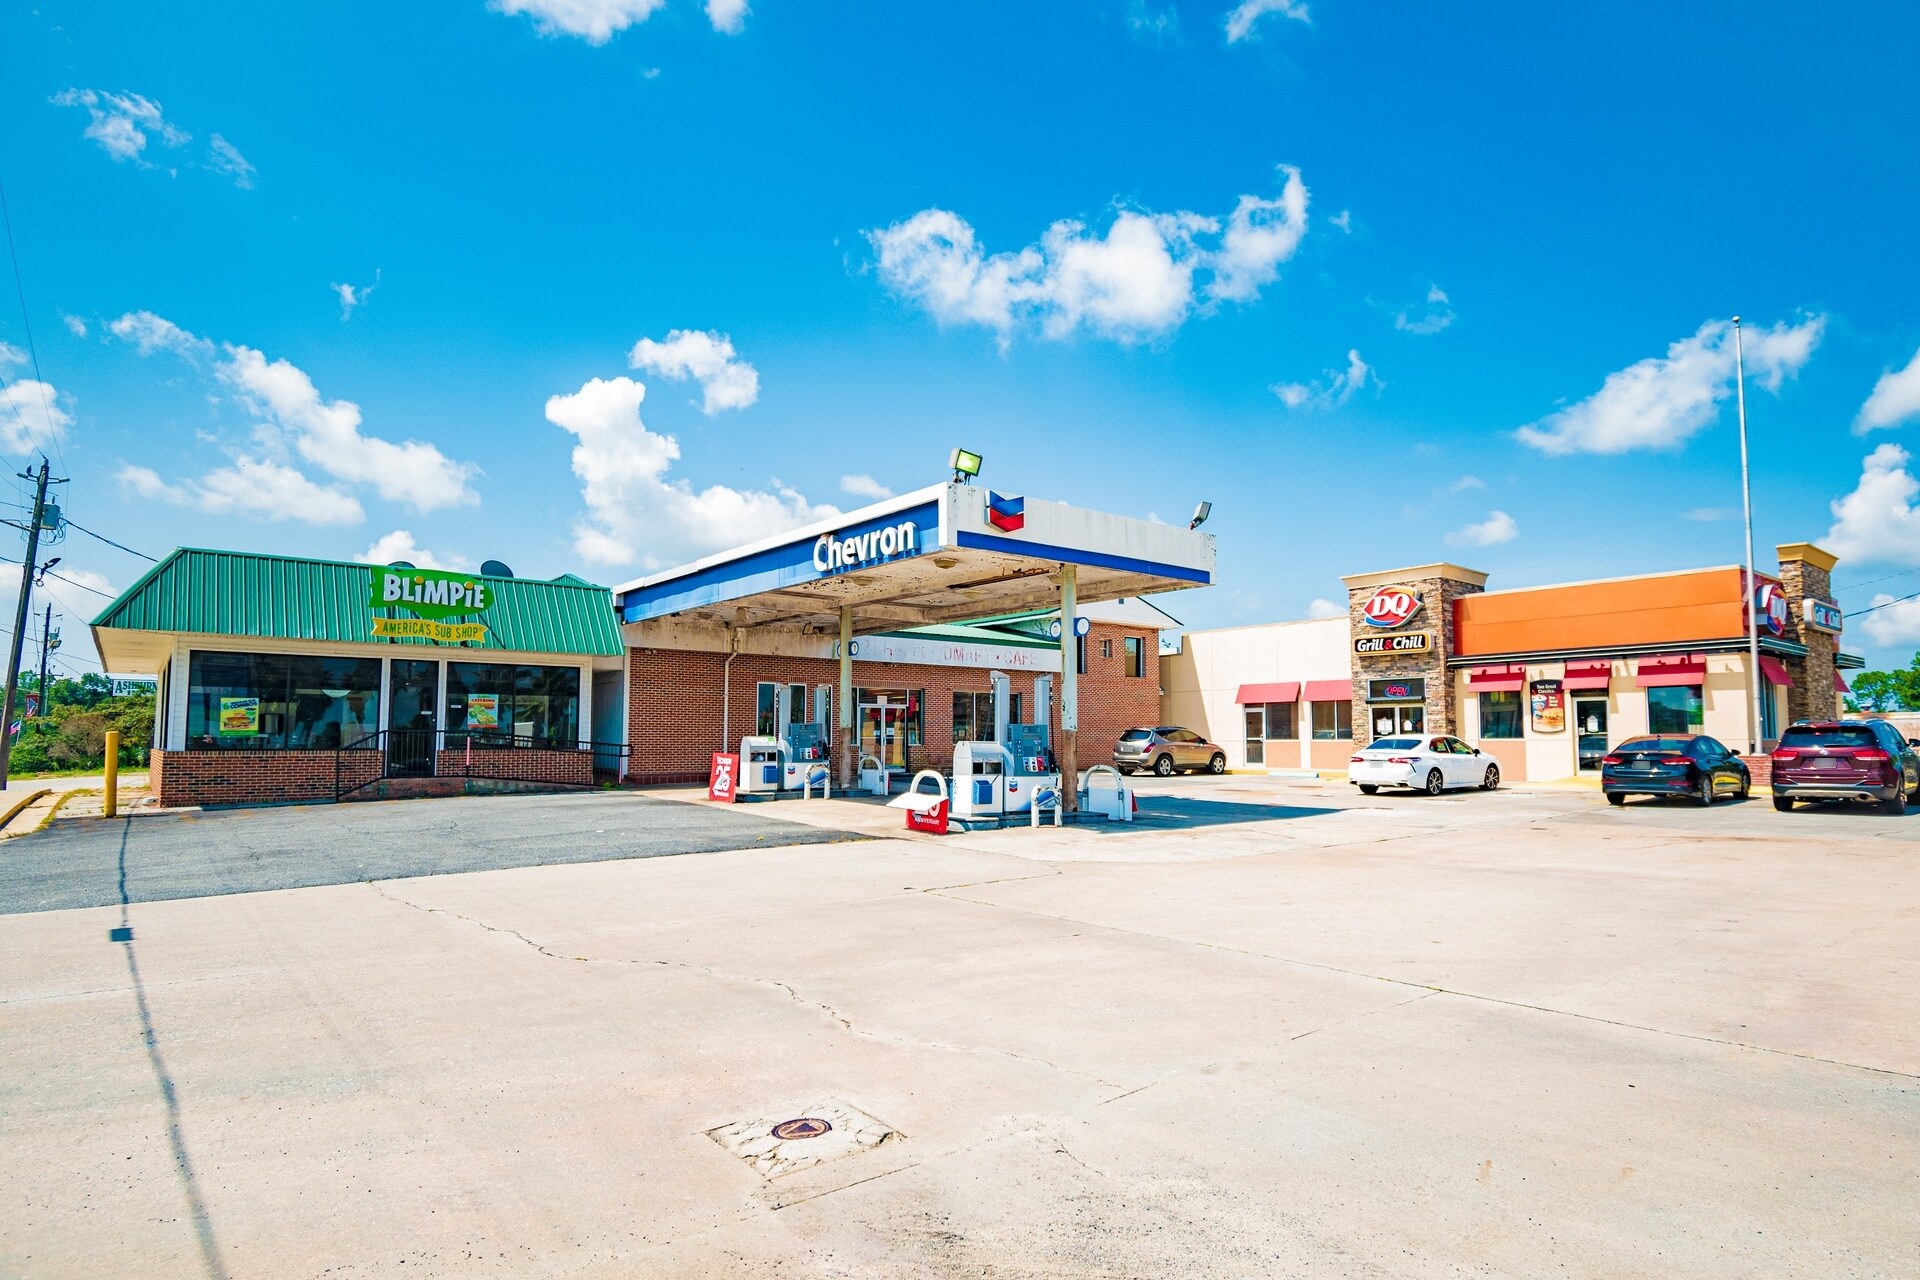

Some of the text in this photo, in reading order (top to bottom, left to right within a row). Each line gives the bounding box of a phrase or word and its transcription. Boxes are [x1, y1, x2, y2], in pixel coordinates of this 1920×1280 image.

[813, 521, 917, 572] Chevron
[1371, 594, 1411, 617] DQ
[435, 625, 451, 638] SUB
[455, 626, 479, 639] SHOP
[1357, 638, 1384, 652] Grill
[1393, 635, 1424, 650] Chill
[1387, 685, 1408, 696] OPEN
[712, 765, 731, 791] 25
